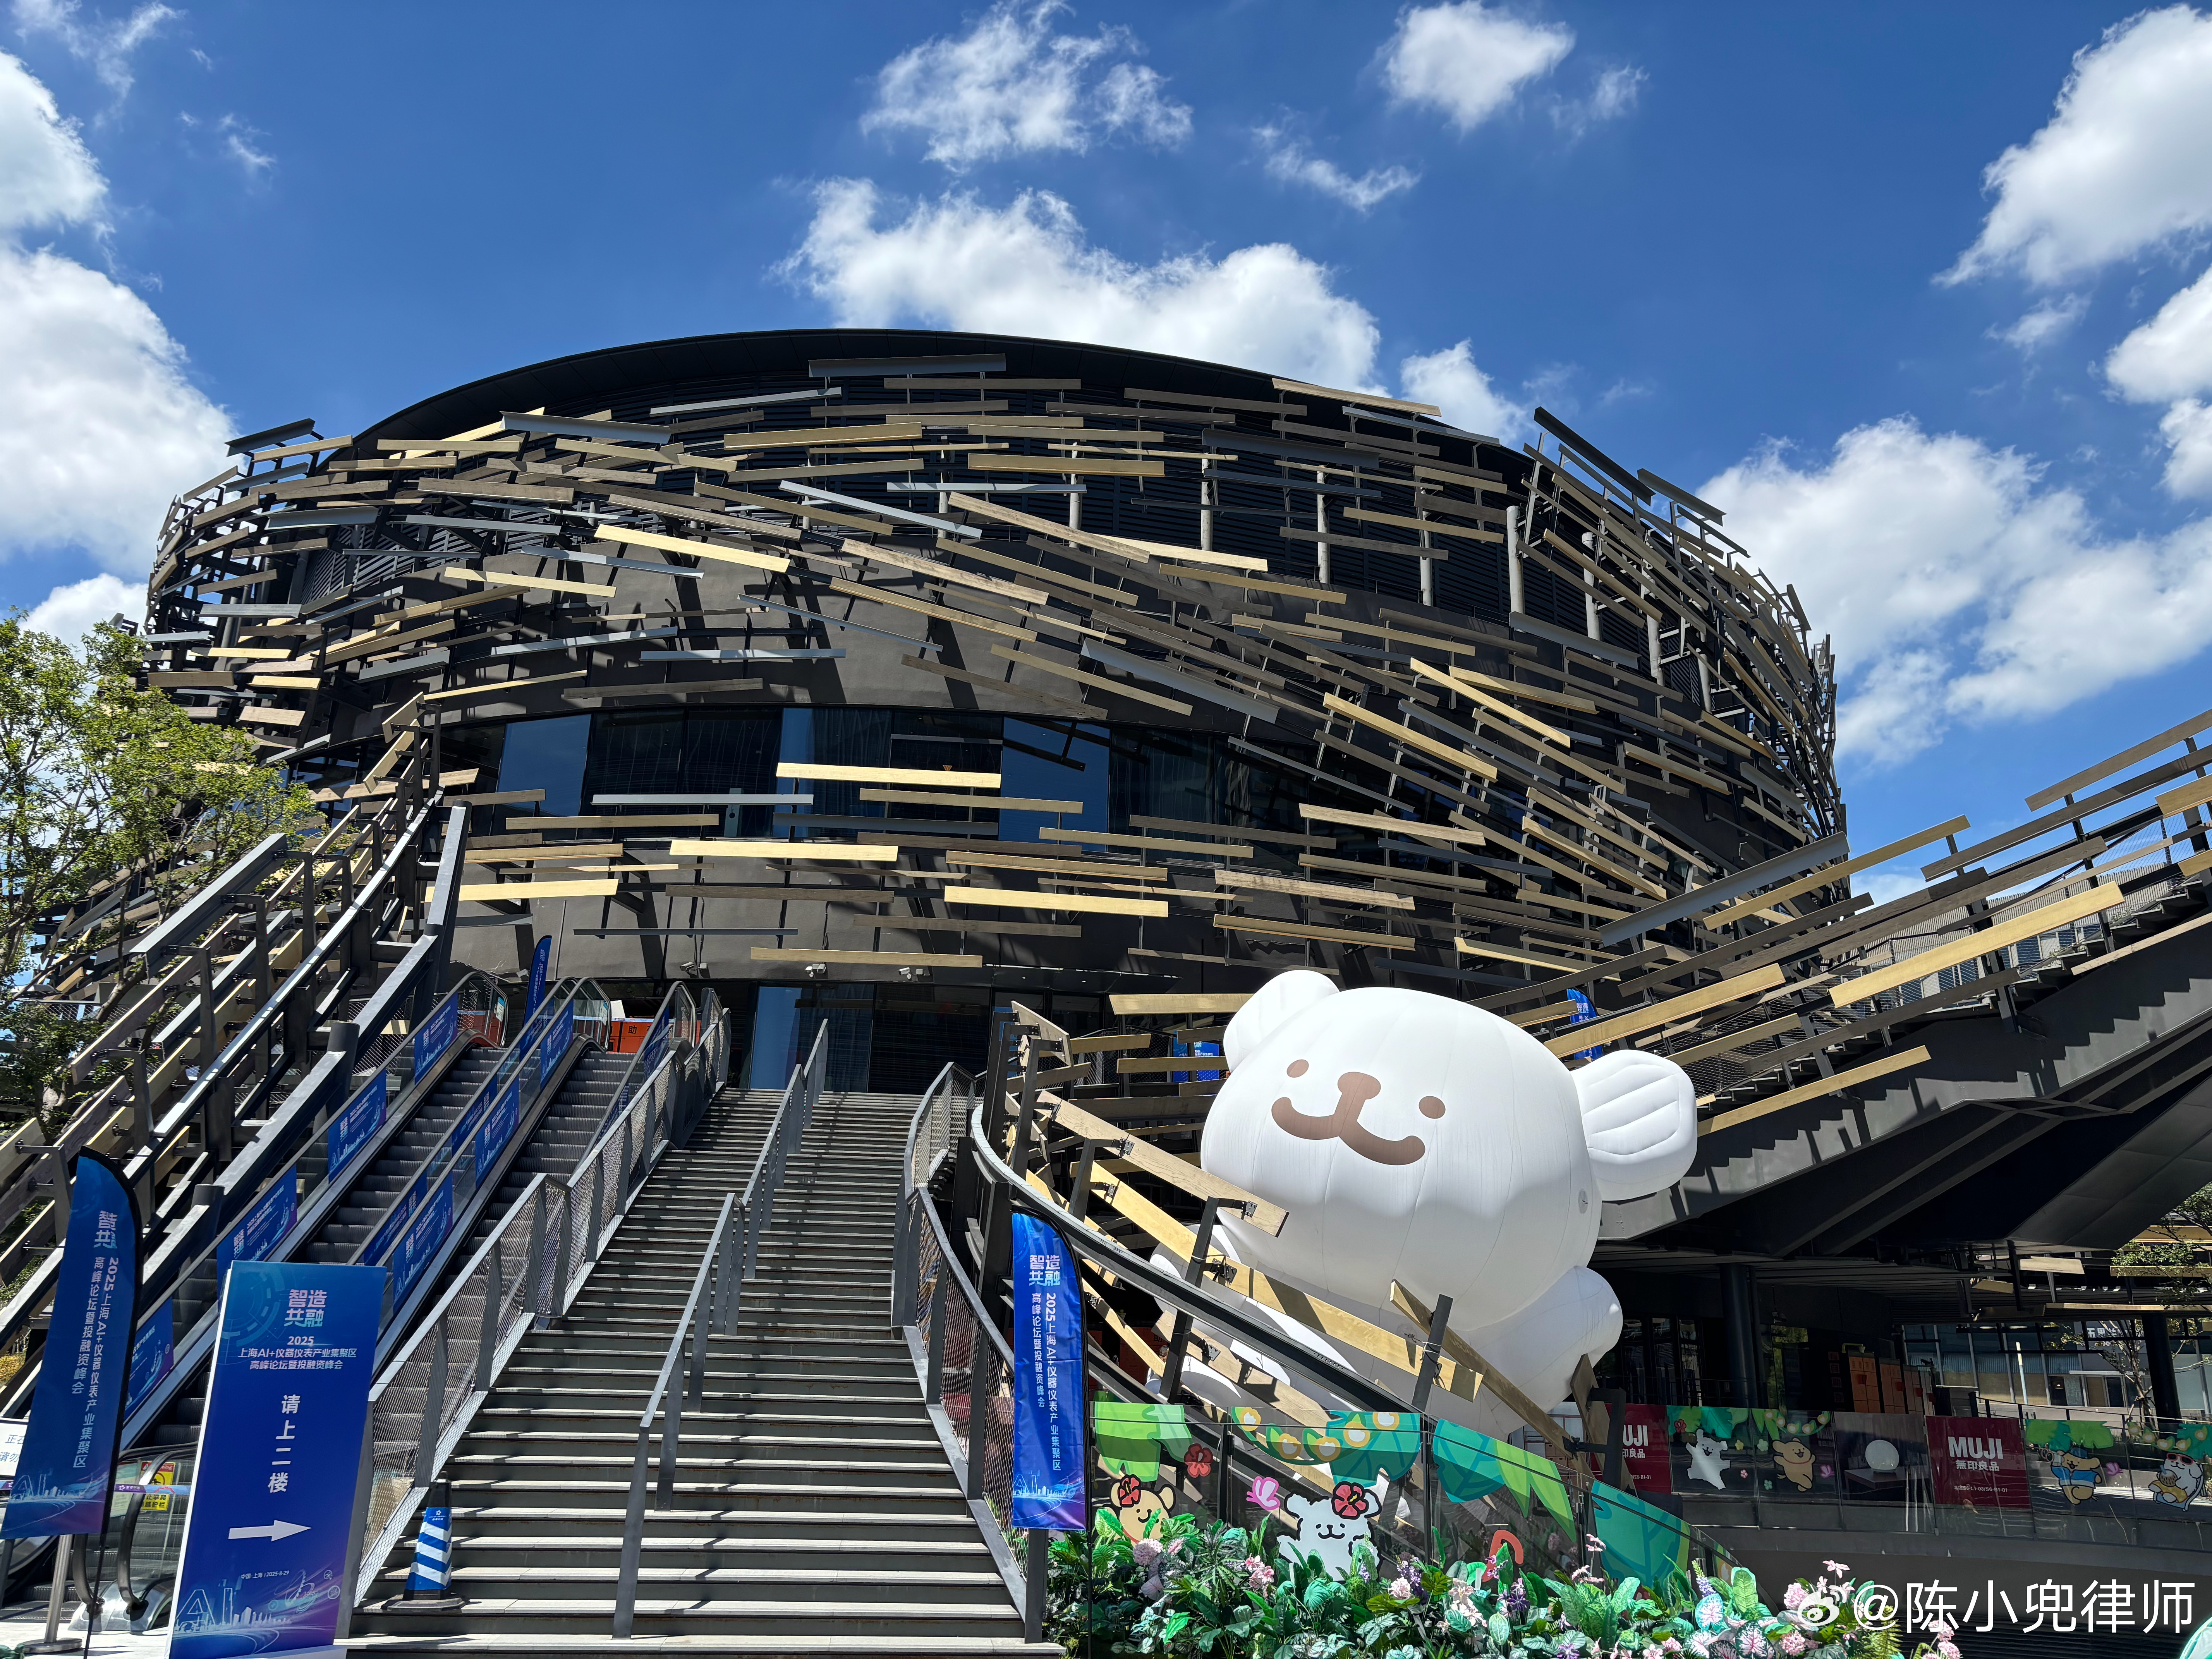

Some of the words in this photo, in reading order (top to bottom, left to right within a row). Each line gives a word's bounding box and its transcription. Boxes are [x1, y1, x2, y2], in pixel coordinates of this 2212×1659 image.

[1030, 1254, 1060, 1270] 智造
[1029, 1270, 1060, 1286] 共融
[289, 1289, 328, 1308] 智造
[71, 1257, 105, 1394] 高峰论坛暨投融资峰会
[284, 1309, 325, 1327] 共融
[287, 1336, 314, 1345] 2025
[238, 1348, 358, 1358] 上海AI+仪器仪表产业集聚区
[1032, 1293, 1045, 1407] 高峰论坛暨投融资峰会
[250, 1360, 343, 1370] 高峰论坛暨投融资峰会
[268, 1394, 301, 1493] 请上二楼
[1948, 1436, 2003, 1459] MUJI
[1956, 1459, 2000, 1472] 無印良品
